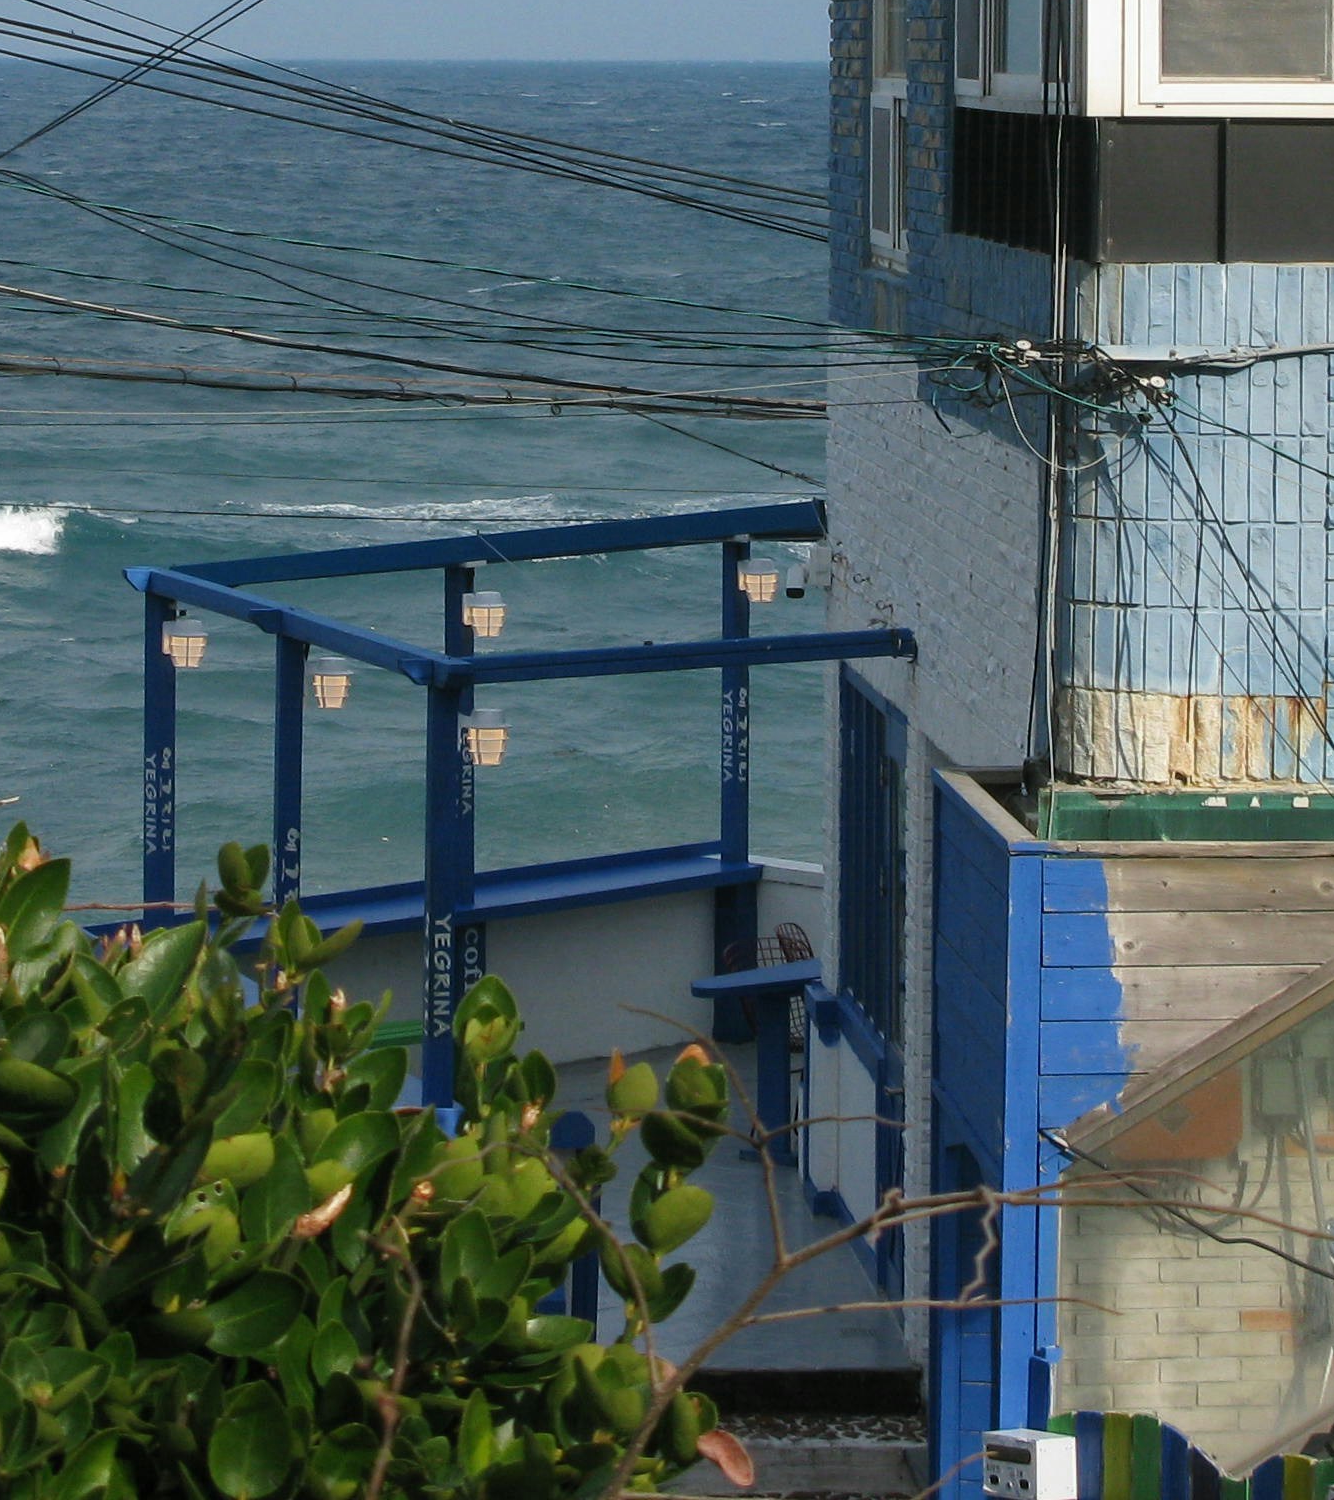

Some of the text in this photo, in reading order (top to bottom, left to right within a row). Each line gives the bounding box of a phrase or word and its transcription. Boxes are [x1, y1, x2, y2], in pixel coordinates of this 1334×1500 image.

[723, 689, 734, 782] YEGRINA
[145, 752, 157, 854] YEGRINA
[433, 912, 452, 1038] YEGRINA
